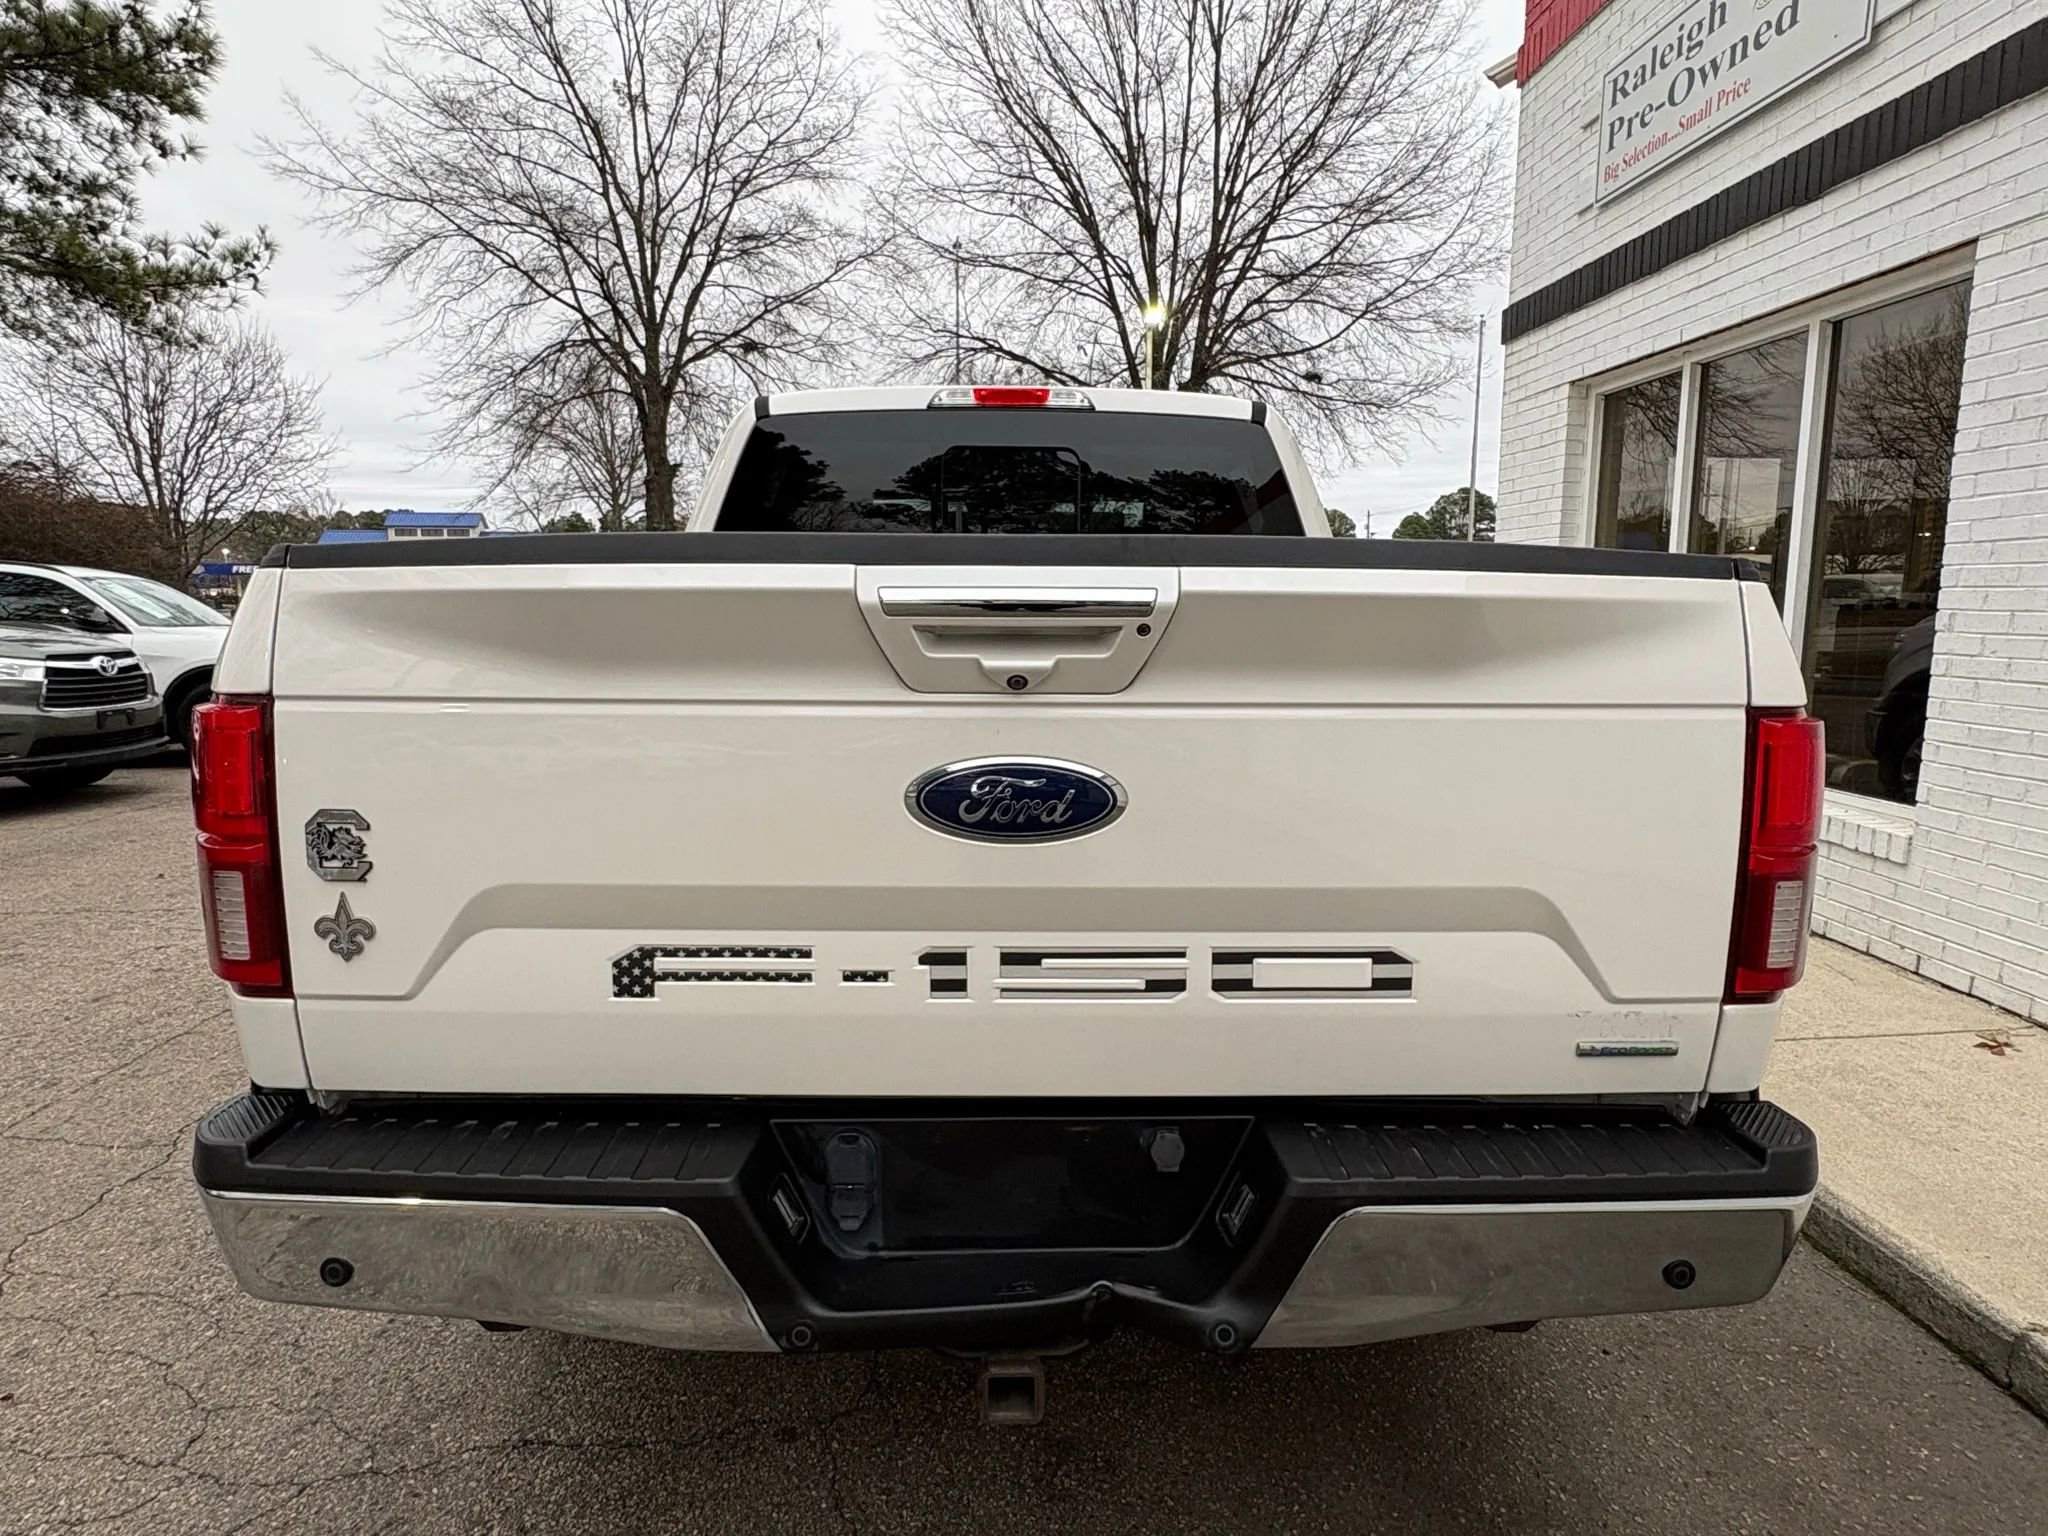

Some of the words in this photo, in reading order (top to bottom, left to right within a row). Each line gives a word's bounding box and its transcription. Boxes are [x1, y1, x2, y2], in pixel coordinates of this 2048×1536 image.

[1605, 0, 1800, 154] Pre-Owned
[1608, 0, 1728, 111] Raleigh
[1603, 161, 1620, 184] Big
[1715, 77, 1751, 113] Price
[958, 775, 1075, 824] Ford
[609, 944, 1415, 1001] F-150
